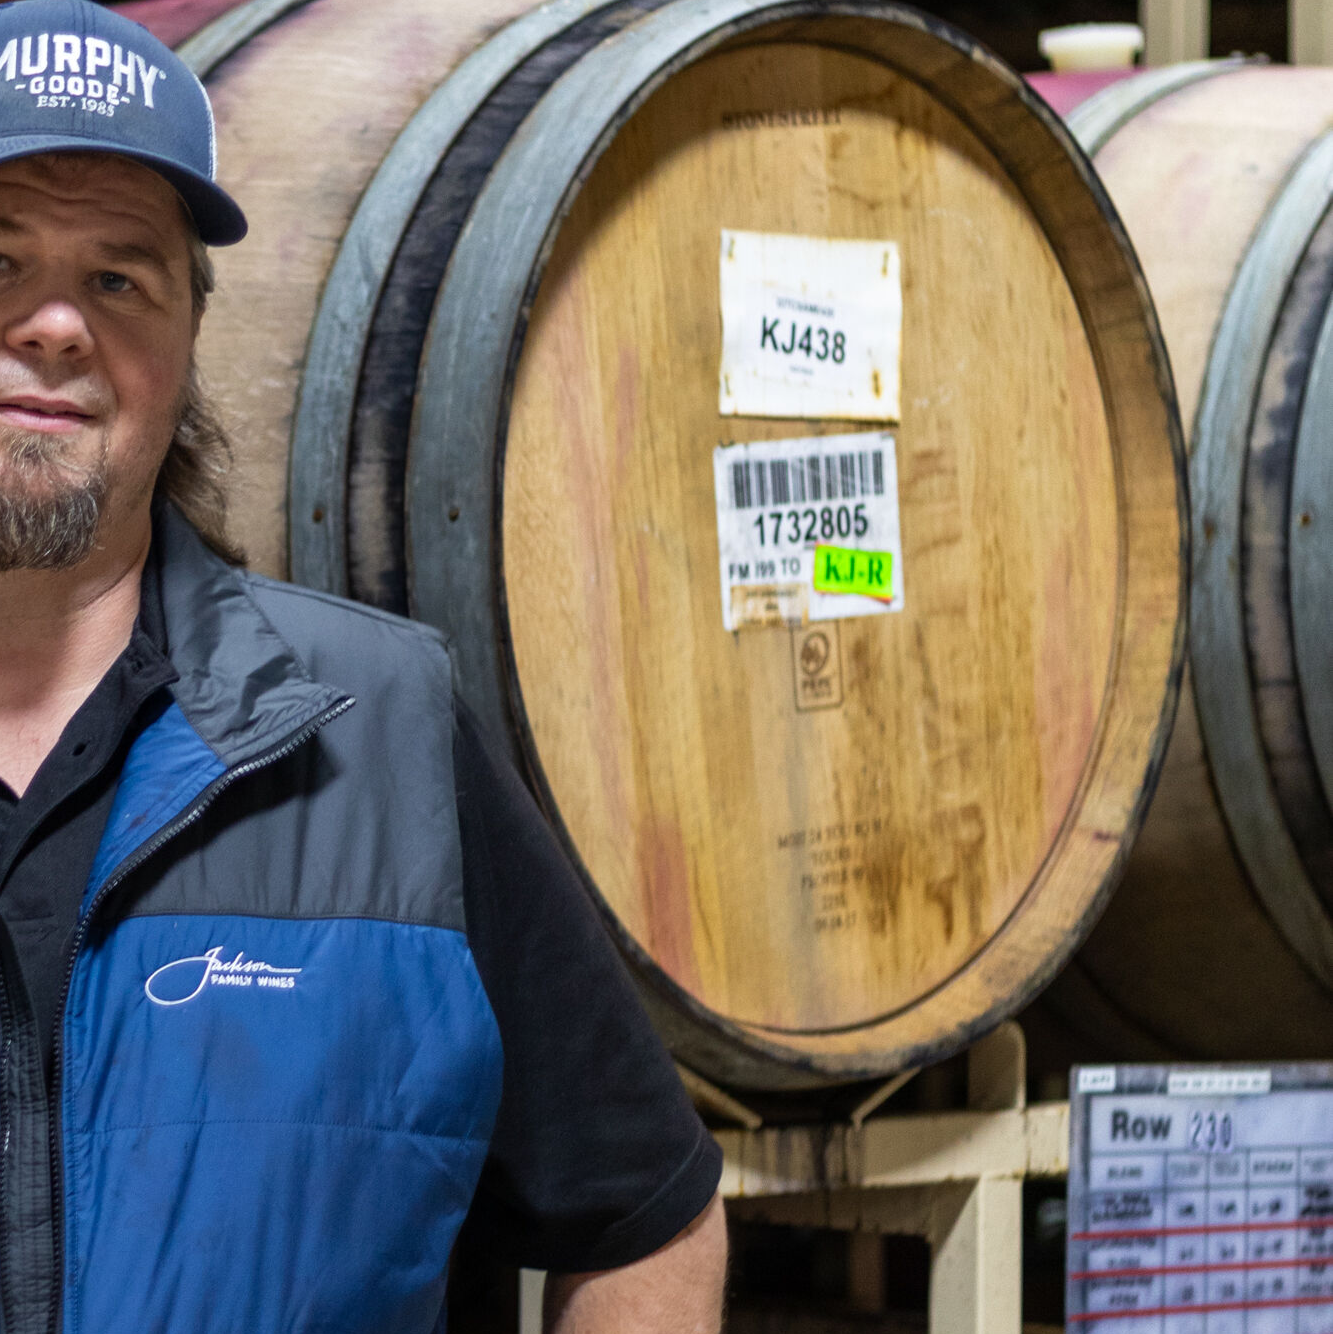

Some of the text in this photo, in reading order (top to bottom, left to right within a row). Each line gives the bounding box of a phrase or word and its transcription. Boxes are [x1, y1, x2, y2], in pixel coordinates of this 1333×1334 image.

[760, 315, 847, 364] KJ438
[753, 503, 869, 547] 1732805
[824, 551, 884, 586] KJ-R
[144, 945, 303, 1006] Jackson
[210, 973, 296, 989] FAMILY WINES
[1110, 1107, 1172, 1142] Row
